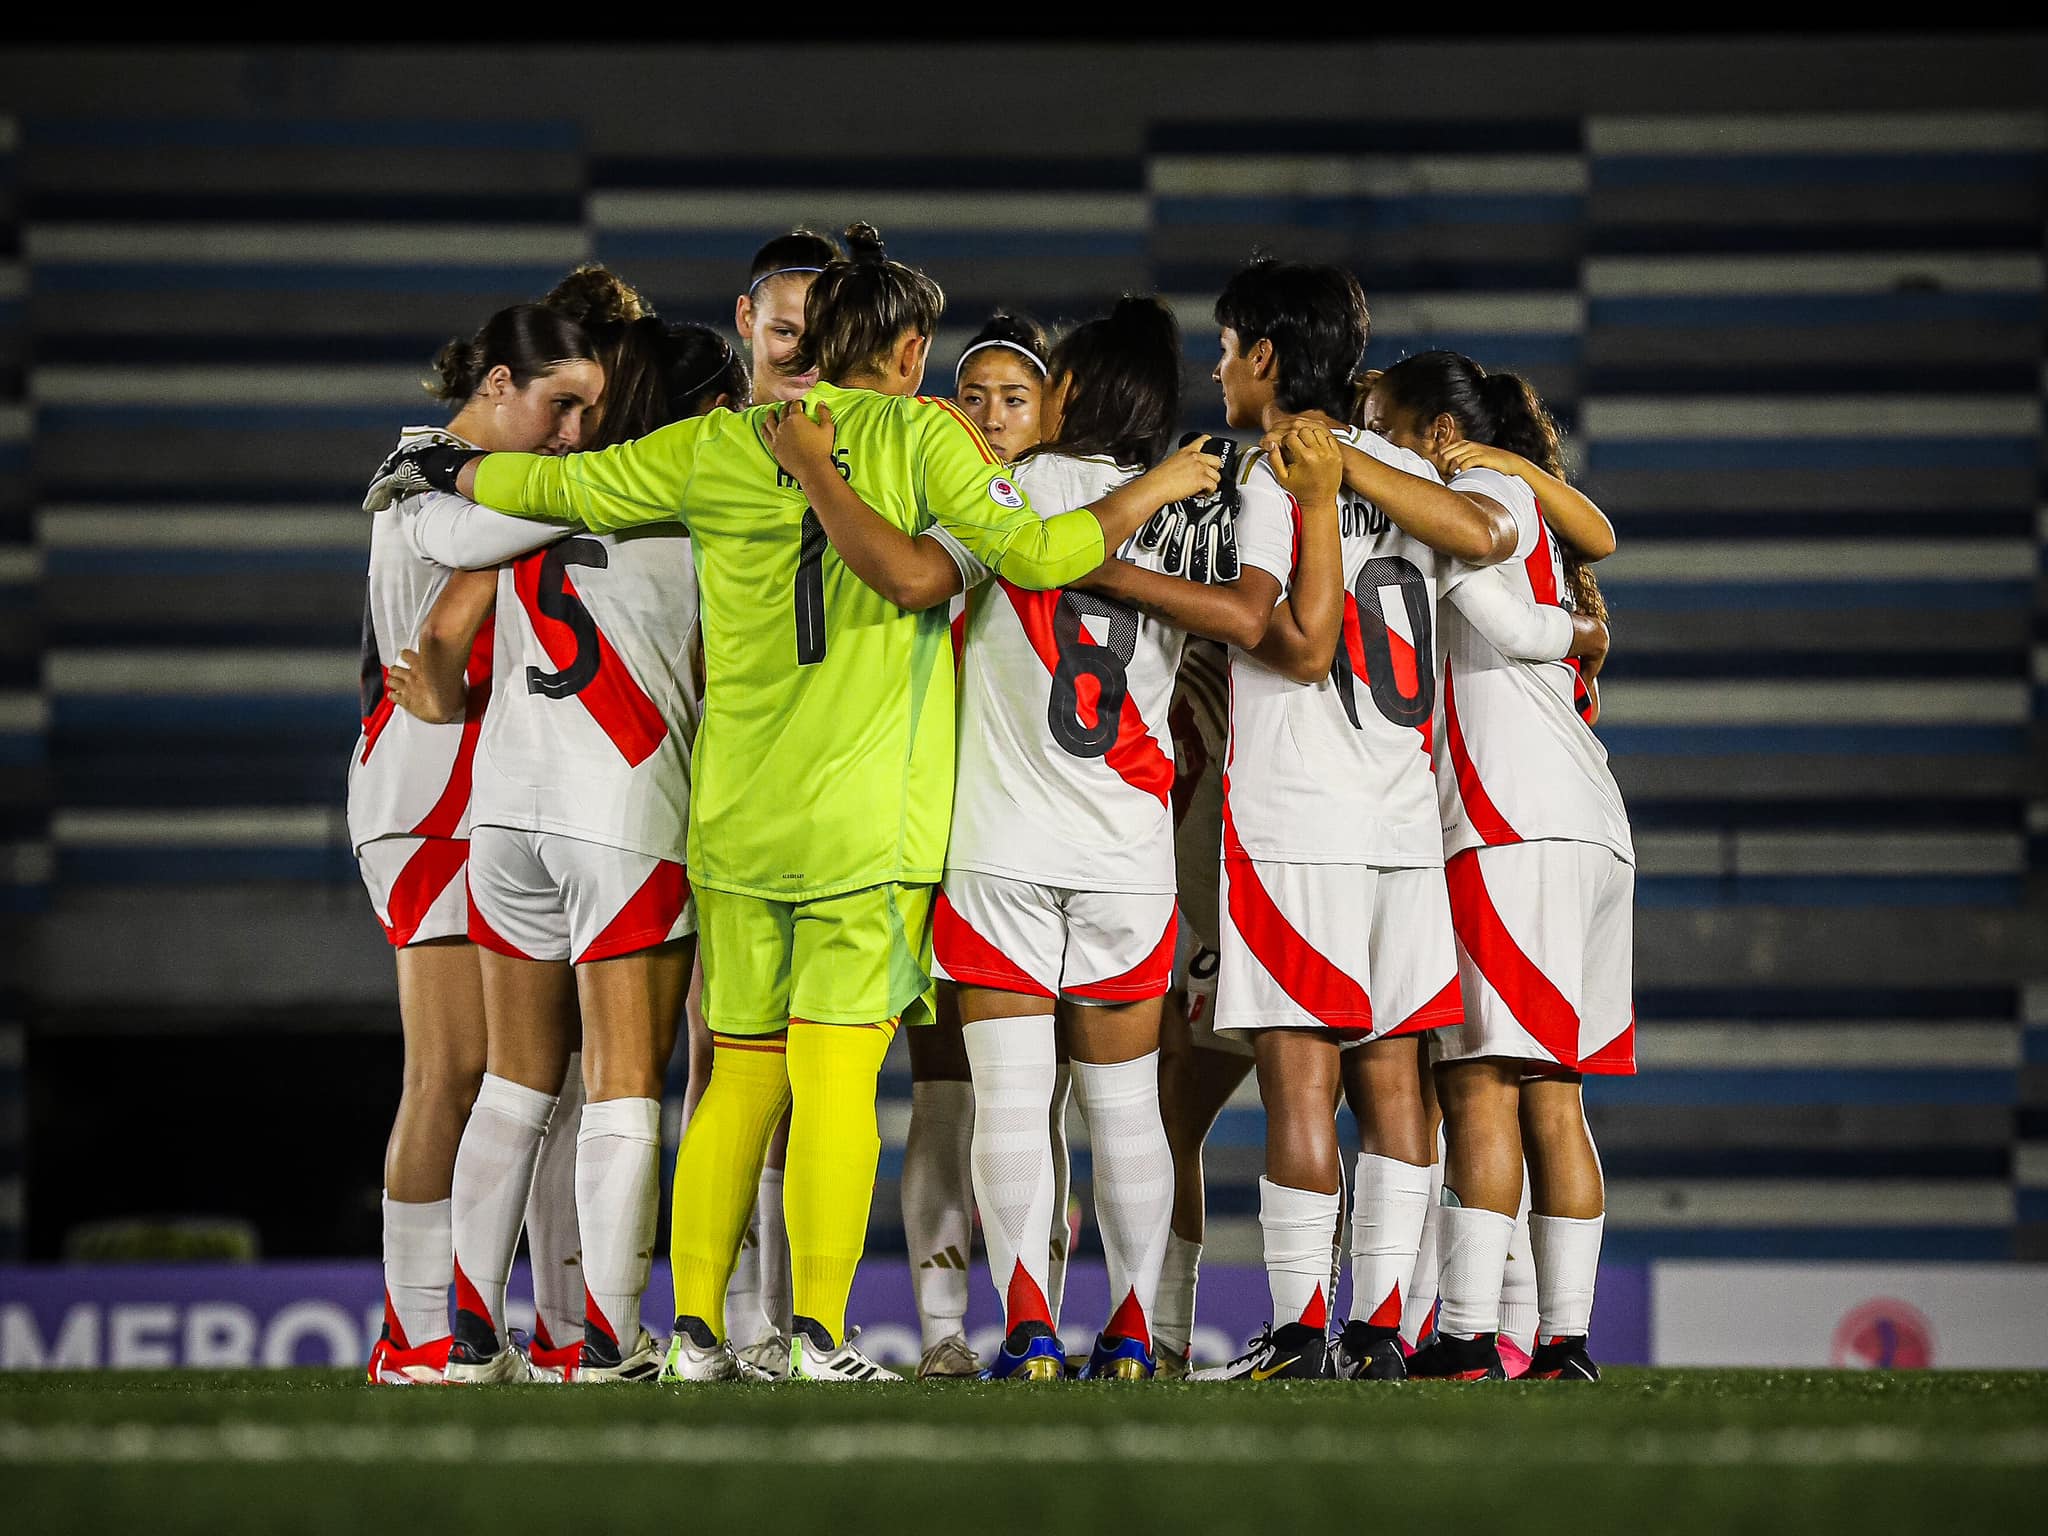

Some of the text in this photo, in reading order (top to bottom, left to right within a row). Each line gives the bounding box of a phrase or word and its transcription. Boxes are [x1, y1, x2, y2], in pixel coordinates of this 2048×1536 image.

[526, 537, 609, 700] 5
[794, 506, 828, 666] 1
[1048, 588, 1139, 758] 8
